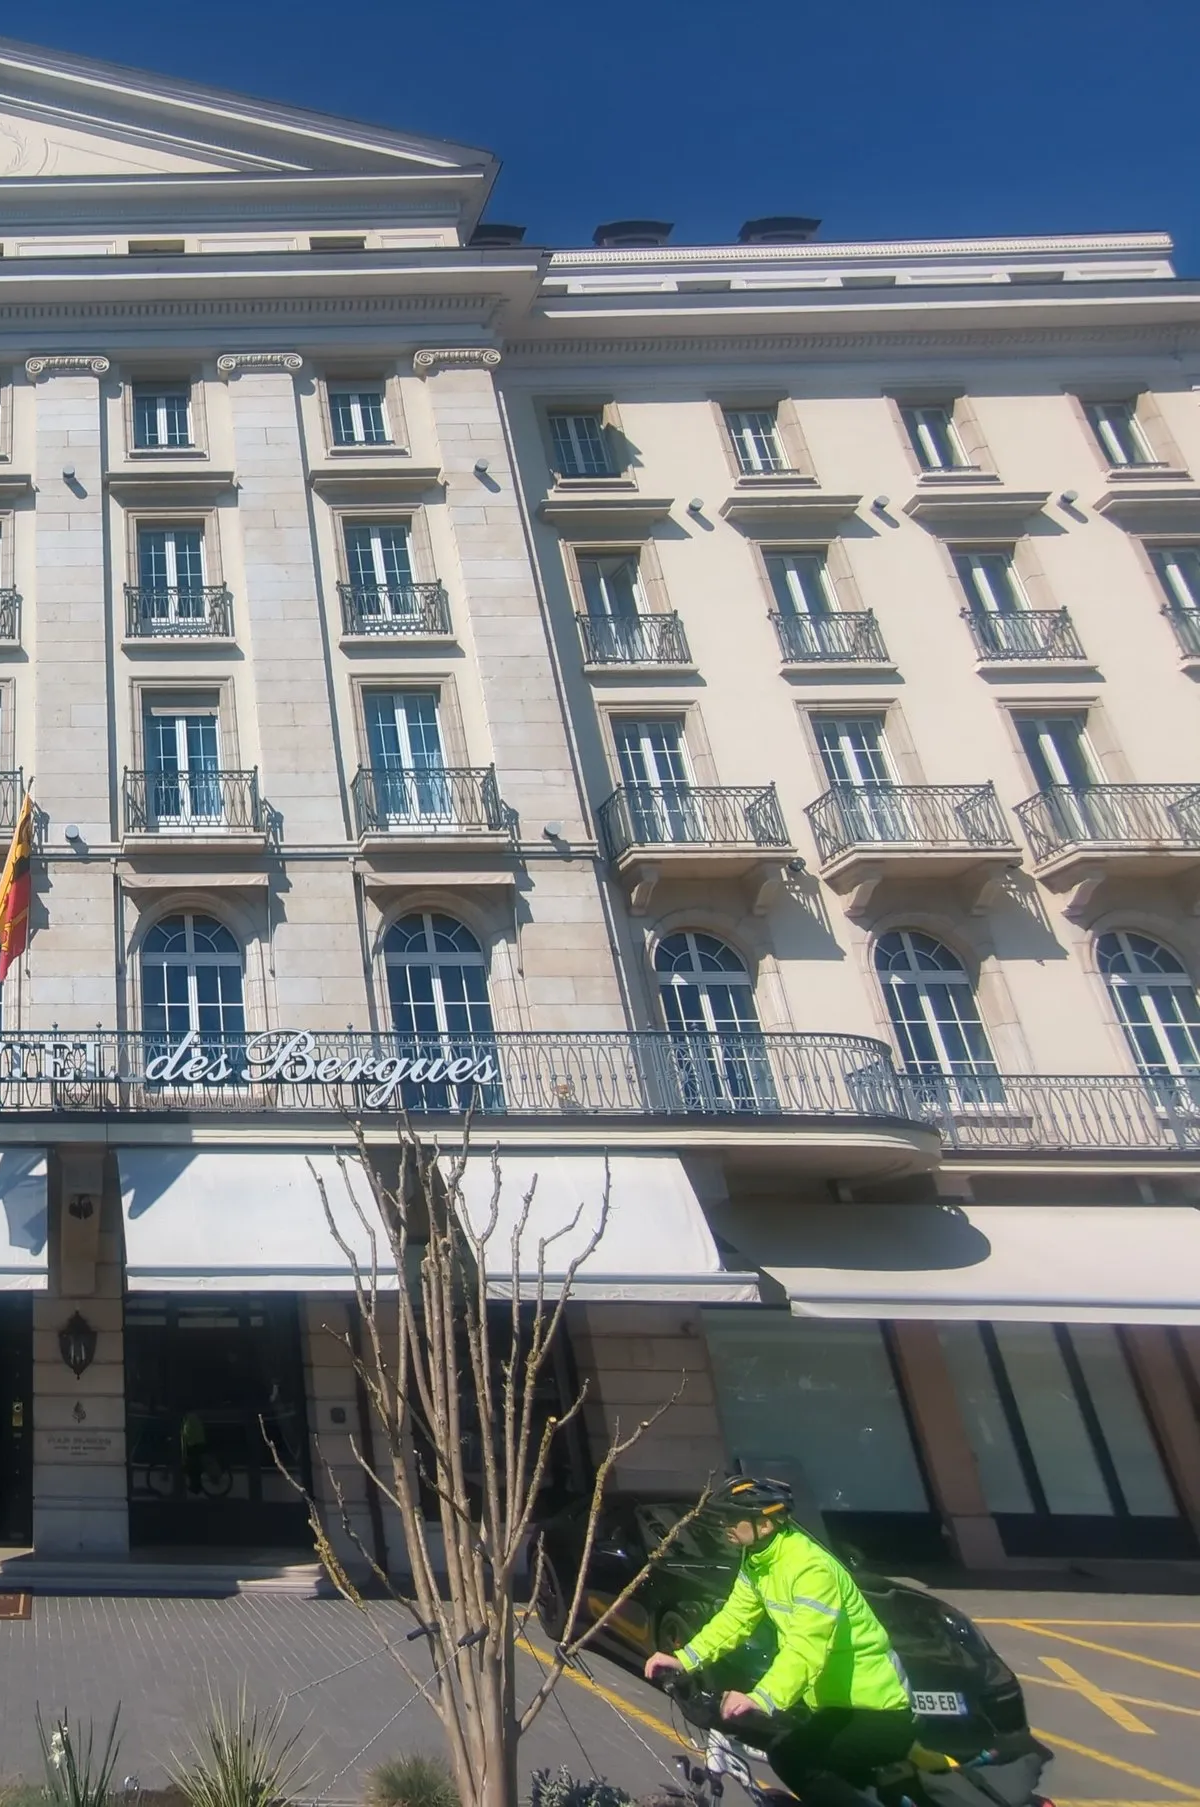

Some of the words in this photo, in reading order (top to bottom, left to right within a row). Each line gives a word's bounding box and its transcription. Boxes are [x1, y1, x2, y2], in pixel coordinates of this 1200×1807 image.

[146, 1030, 233, 1081] des
[241, 1028, 499, 1106] Bergues
[912, 1694, 957, 1711] 69-EB
